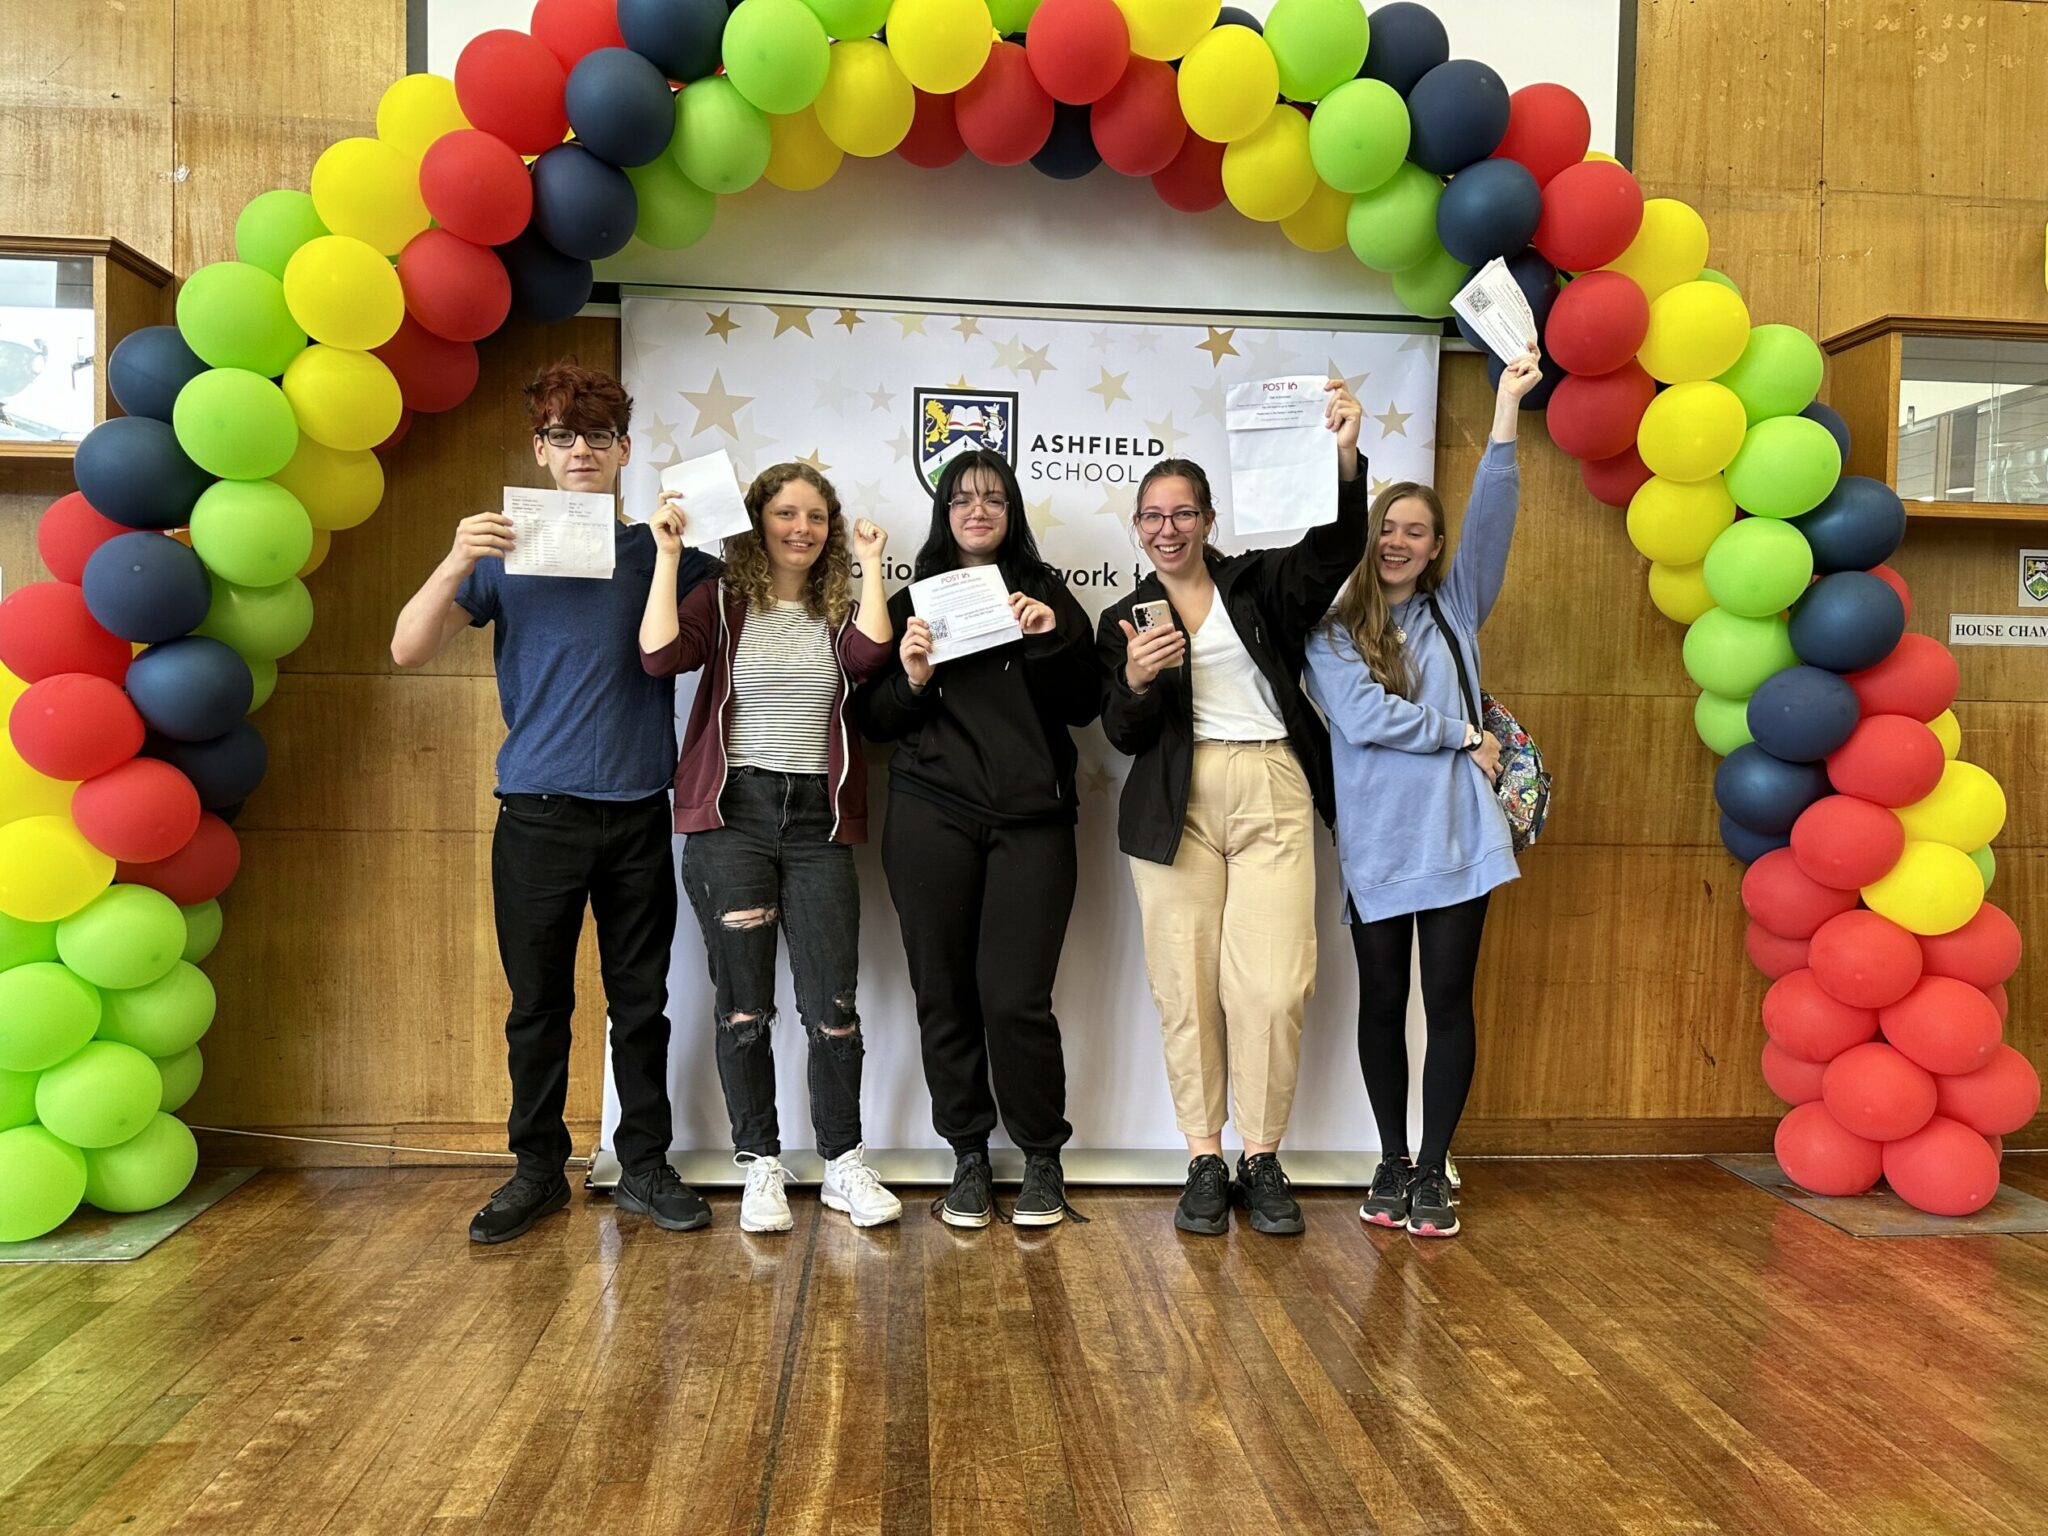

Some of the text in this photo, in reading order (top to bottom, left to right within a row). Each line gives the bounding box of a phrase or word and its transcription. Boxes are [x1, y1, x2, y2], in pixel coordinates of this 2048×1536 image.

[1262, 382, 1286, 392] POST
[1030, 434, 1164, 457] ASHFIELD
[1031, 461, 1139, 483] SCHOOL
[1955, 624, 2004, 636] HOUSE
